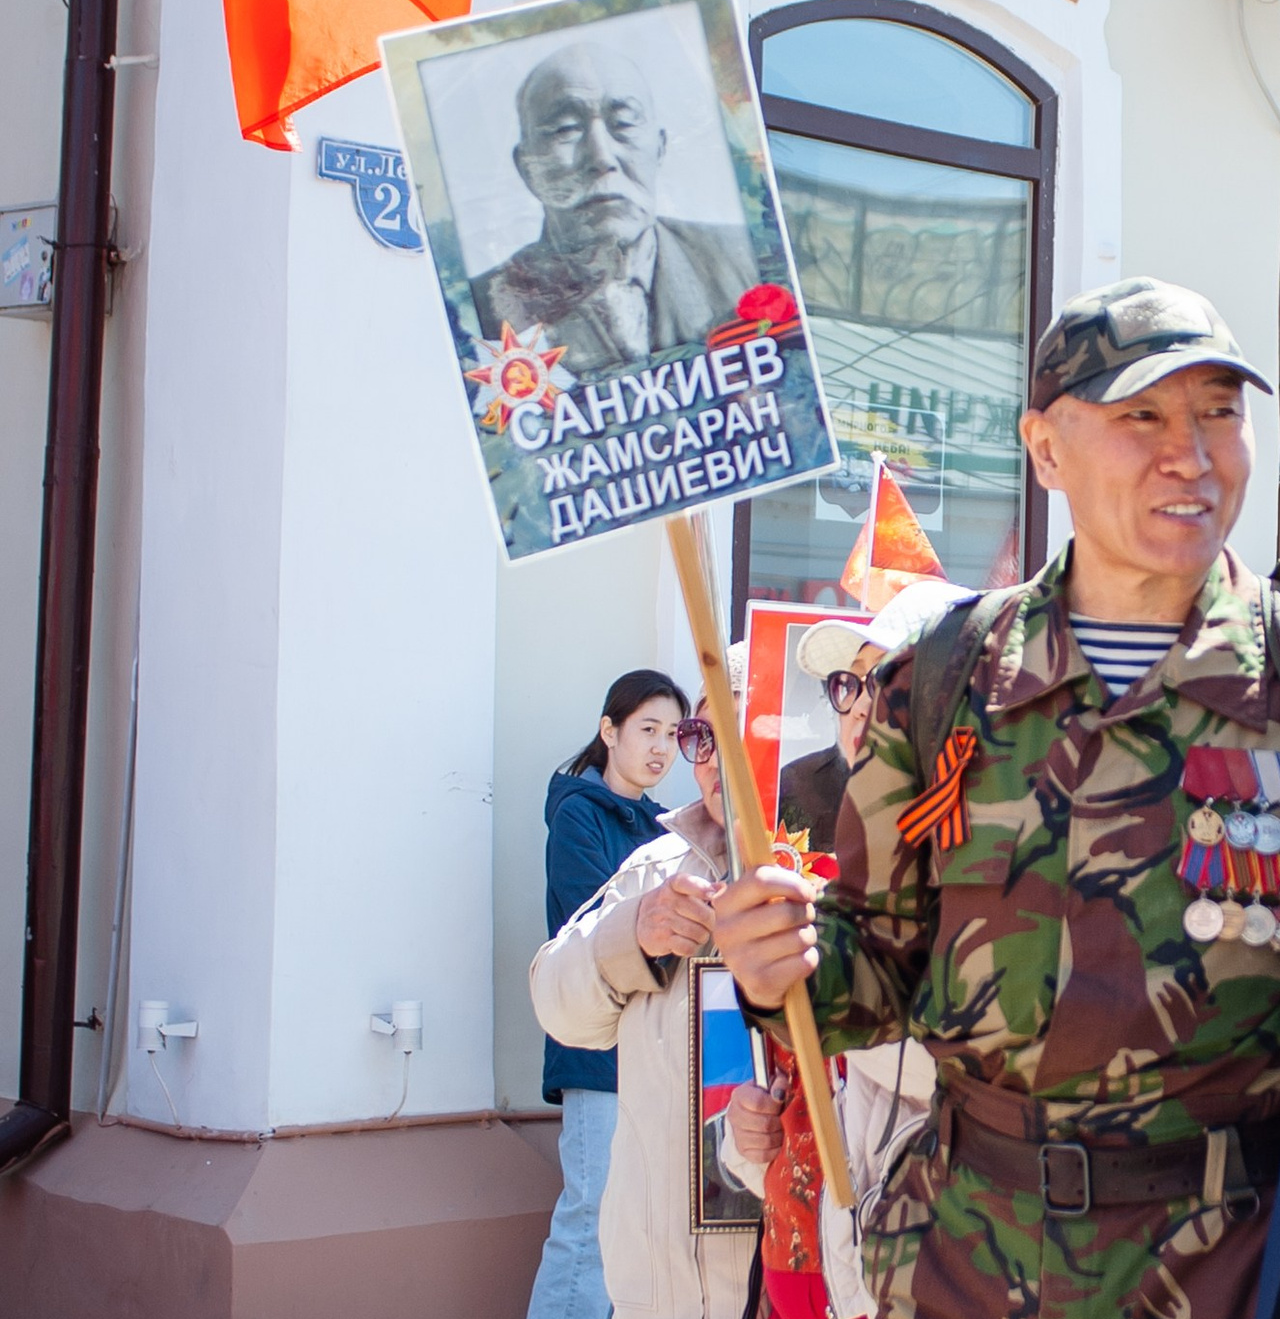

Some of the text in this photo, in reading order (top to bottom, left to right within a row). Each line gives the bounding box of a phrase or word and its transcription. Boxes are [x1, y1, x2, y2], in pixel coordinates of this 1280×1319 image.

[511, 336, 785, 450] САНЖИЕВ
[540, 390, 780, 493] ЖАМСАРАН
[549, 433, 792, 541] ДАШИЕВИЧ
